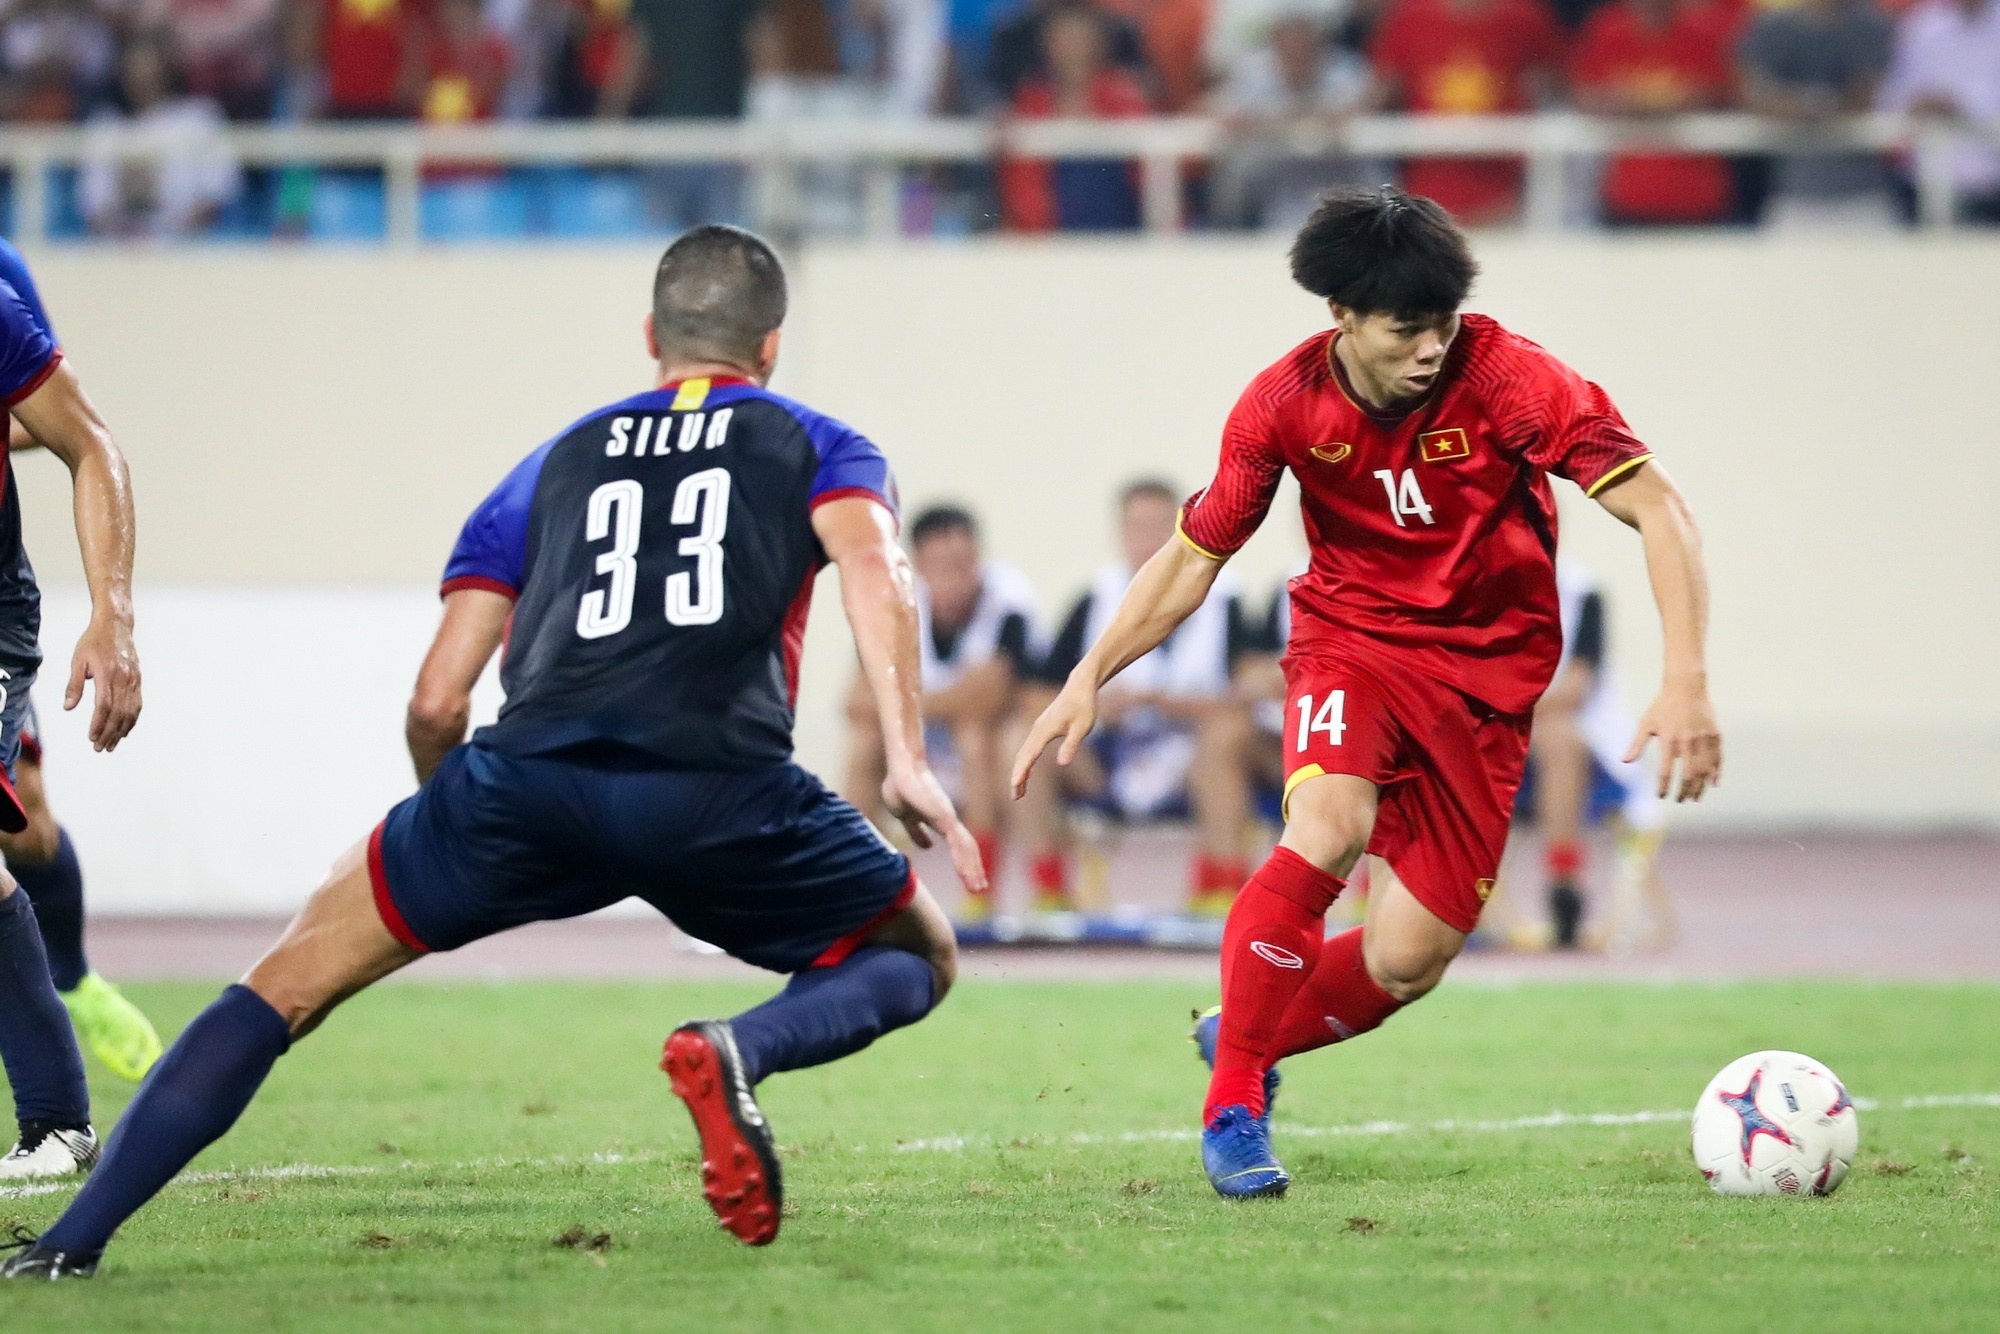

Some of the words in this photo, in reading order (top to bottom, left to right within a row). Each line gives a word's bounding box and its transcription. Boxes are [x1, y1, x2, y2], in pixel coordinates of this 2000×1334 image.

[1373, 468, 1435, 527] 14
[576, 467, 731, 640] 33
[1296, 689, 1347, 753] 14
